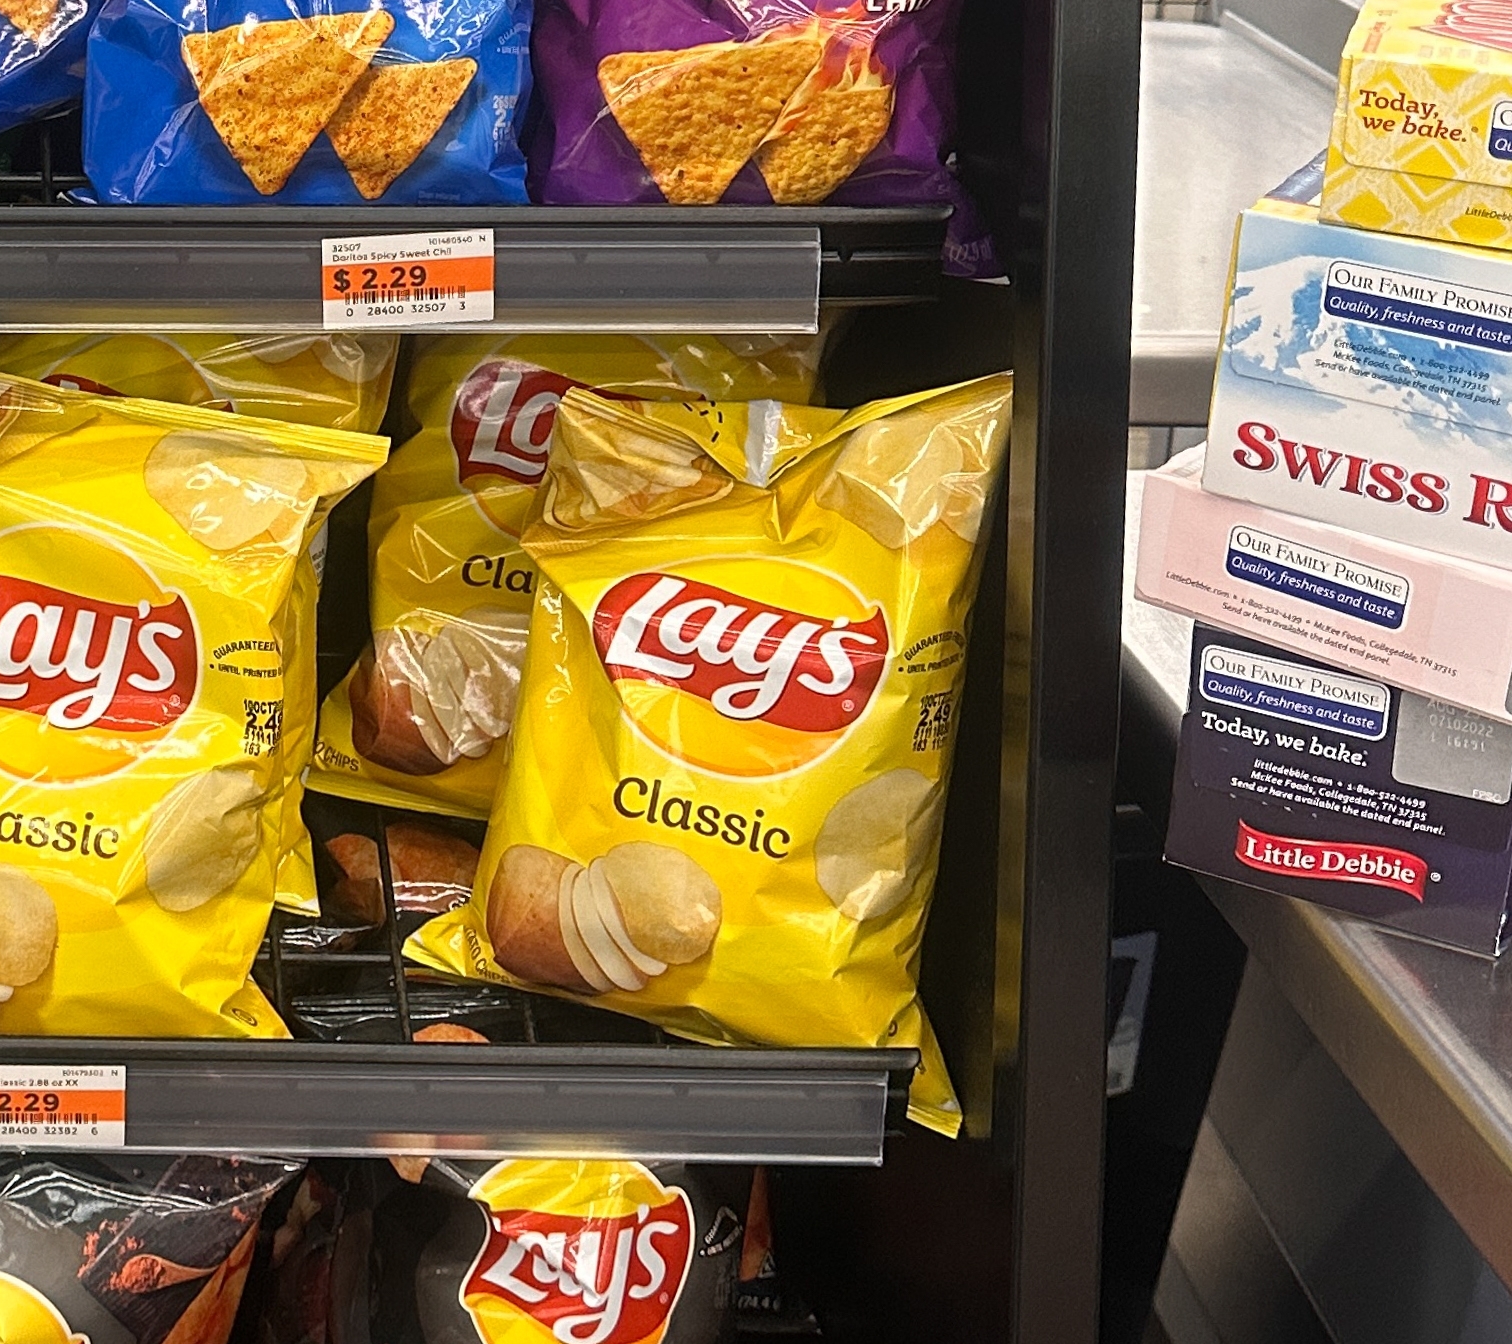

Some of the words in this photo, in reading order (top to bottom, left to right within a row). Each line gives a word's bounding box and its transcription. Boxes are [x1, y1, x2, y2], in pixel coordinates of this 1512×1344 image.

[1360, 89, 1438, 119] Today,
[1362, 116, 1395, 132] we
[1402, 116, 1467, 142] bake.
[333, 269, 350, 293] $
[362, 265, 426, 290] 2.29
[1330, 296, 1379, 319] Quality,
[1380, 306, 1444, 330] freshness
[1447, 322, 1475, 338] and
[1233, 421, 1450, 516] SWISS
[213, 641, 274, 659] GUARANTEED
[604, 576, 876, 719] Lay's
[1202, 711, 1270, 746] Today,
[1275, 733, 1305, 752] we
[1309, 736, 1368, 767] bake.
[1251, 771, 1283, 787] McKee
[1285, 779, 1316, 796] Foods,
[1319, 788, 1380, 811] Collegedale,
[613, 777, 790, 860] Classic
[1245, 836, 1315, 869] Little
[1320, 851, 1415, 883] Debbie
